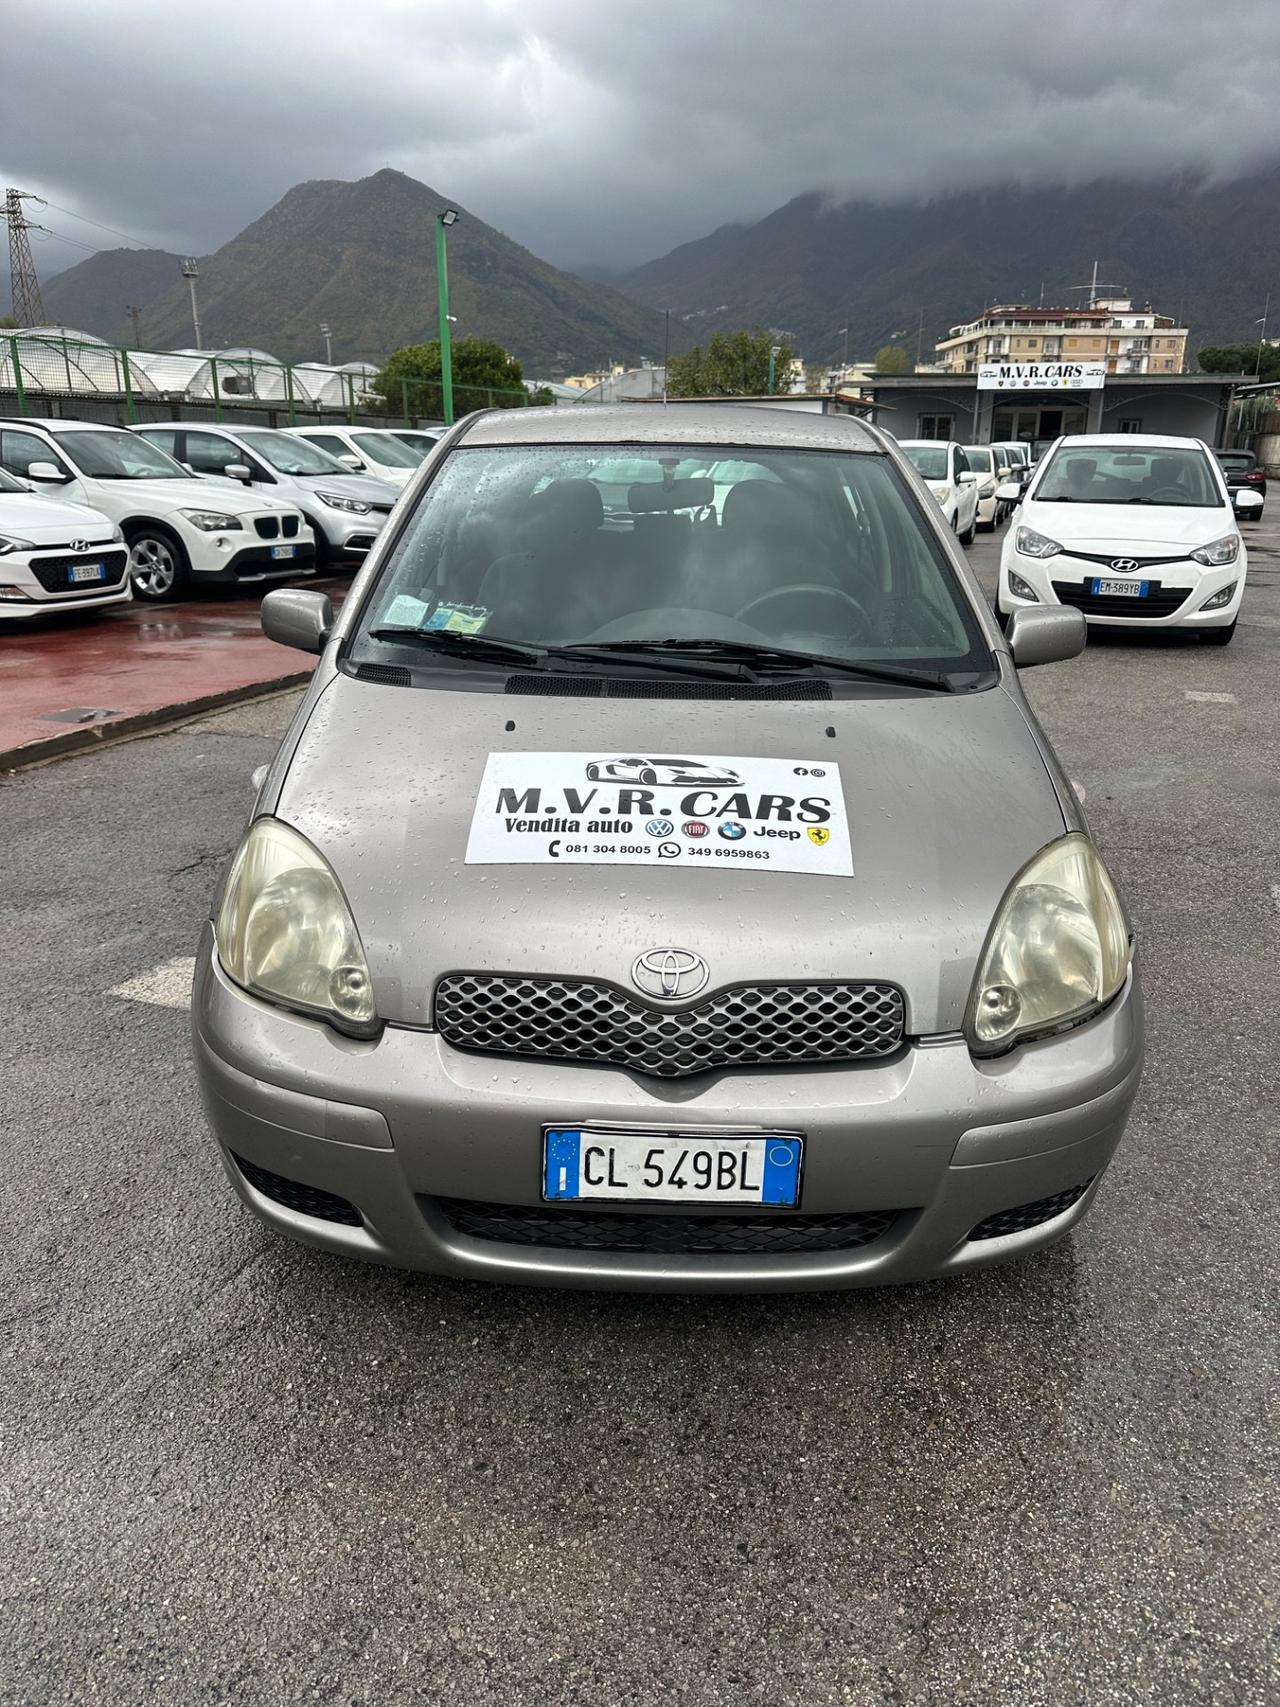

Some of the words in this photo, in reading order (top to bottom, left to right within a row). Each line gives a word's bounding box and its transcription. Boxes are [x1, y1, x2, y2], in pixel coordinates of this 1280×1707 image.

[505, 817, 580, 833] Vendita
[587, 818, 633, 834] auto
[688, 824, 705, 834] FIAT
[753, 826, 801, 841] Jeep
[565, 844, 588, 853] 081
[593, 844, 616, 853] 304
[619, 845, 651, 854] 8005
[687, 847, 712, 857] 349
[715, 848, 771, 860] 6959863
[584, 1146, 628, 1188] CL
[643, 1149, 760, 1191] 549BL
